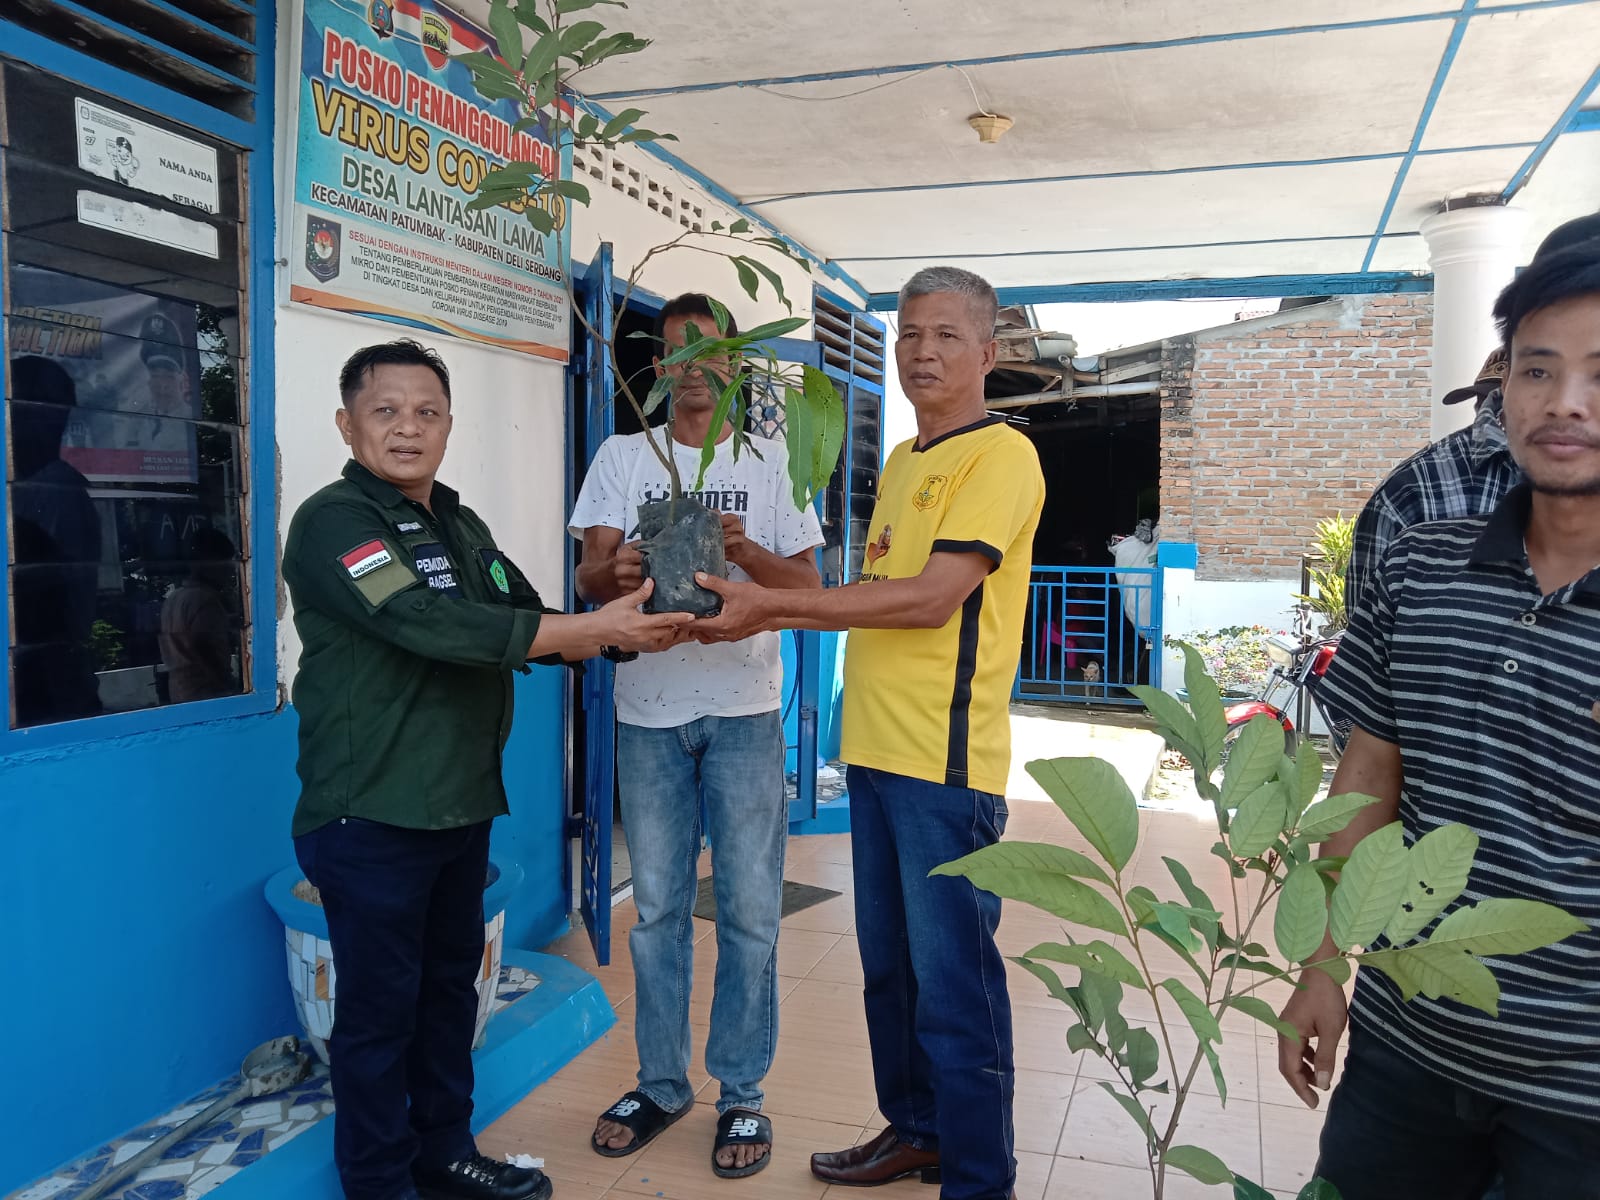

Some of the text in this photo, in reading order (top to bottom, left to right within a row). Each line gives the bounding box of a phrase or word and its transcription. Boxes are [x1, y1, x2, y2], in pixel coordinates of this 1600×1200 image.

[325, 31, 401, 106] POSKO
[311, 79, 430, 174] VIRUS
[159, 157, 213, 183] NAMA ANDA
[312, 183, 388, 222] KECAMATAN
[391, 211, 445, 242] PATUMBAK
[455, 233, 504, 262] KABUPATEN
[506, 252, 523, 269] DELI
[525, 259, 561, 281] SERDANG
[343, 156, 545, 258] DESA LANTASAN LAMA
[349, 230, 377, 247] SESUAI
[378, 239, 409, 256] DENGAN
[410, 249, 445, 267] INSTRUKSI
[446, 259, 472, 276] MENTERI
[472, 268, 492, 282] DALAM
[493, 275, 512, 287] NEGERI
[513, 283, 532, 295] NOMOR
[537, 289, 553, 301] TAHUN
[351, 255, 375, 270] MIKRO
[376, 262, 390, 274] DAN
[391, 267, 439, 288] PEMBENTUKAN
[439, 280, 459, 293] POSKO
[460, 286, 495, 303] PENANGANAN
[496, 297, 517, 310] CORONA
[359, 245, 391, 263] TENTANG
[392, 255, 443, 278] PEMBERLAKUAN
[444, 270, 480, 287] PEMBATASAN
[480, 282, 504, 296] KEGIATAN
[504, 289, 535, 304] MASYARAKAT
[363, 271, 370, 281] DI
[371, 272, 401, 289] TINGKAT
[401, 281, 420, 292] DESA
[420, 286, 433, 297] DAN
[433, 290, 466, 308] KELURAHAN
[468, 300, 486, 312] UNTUK
[432, 300, 508, 327] CORONA VIRUS DISEASE 2019
[352, 555, 390, 577] INDONESIA
[415, 556, 452, 573] PEMUDA
